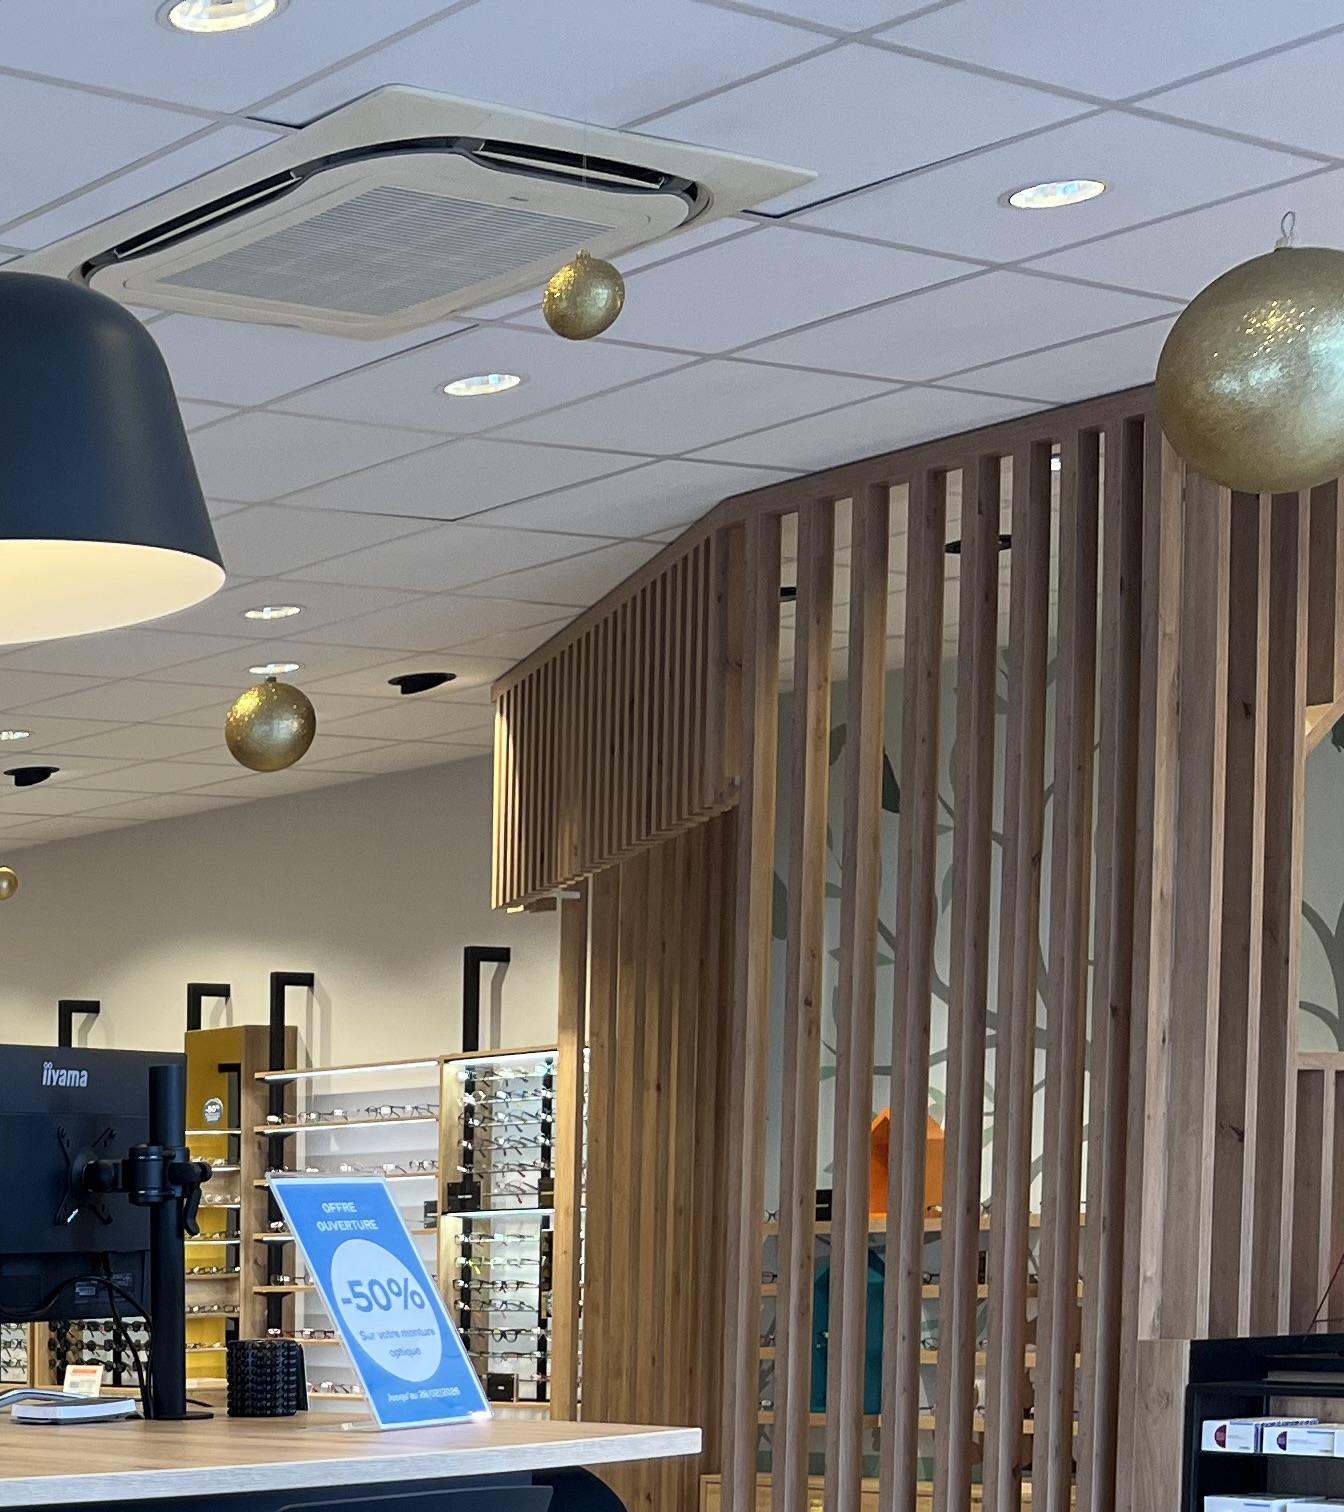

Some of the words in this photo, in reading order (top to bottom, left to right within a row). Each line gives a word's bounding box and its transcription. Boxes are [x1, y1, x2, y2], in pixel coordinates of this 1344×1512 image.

[41, 1061, 89, 1088] iiyama
[322, 1201, 358, 1213] OFFRE
[315, 1219, 380, 1232] OUVERTURE
[340, 1277, 426, 1313] -50%
